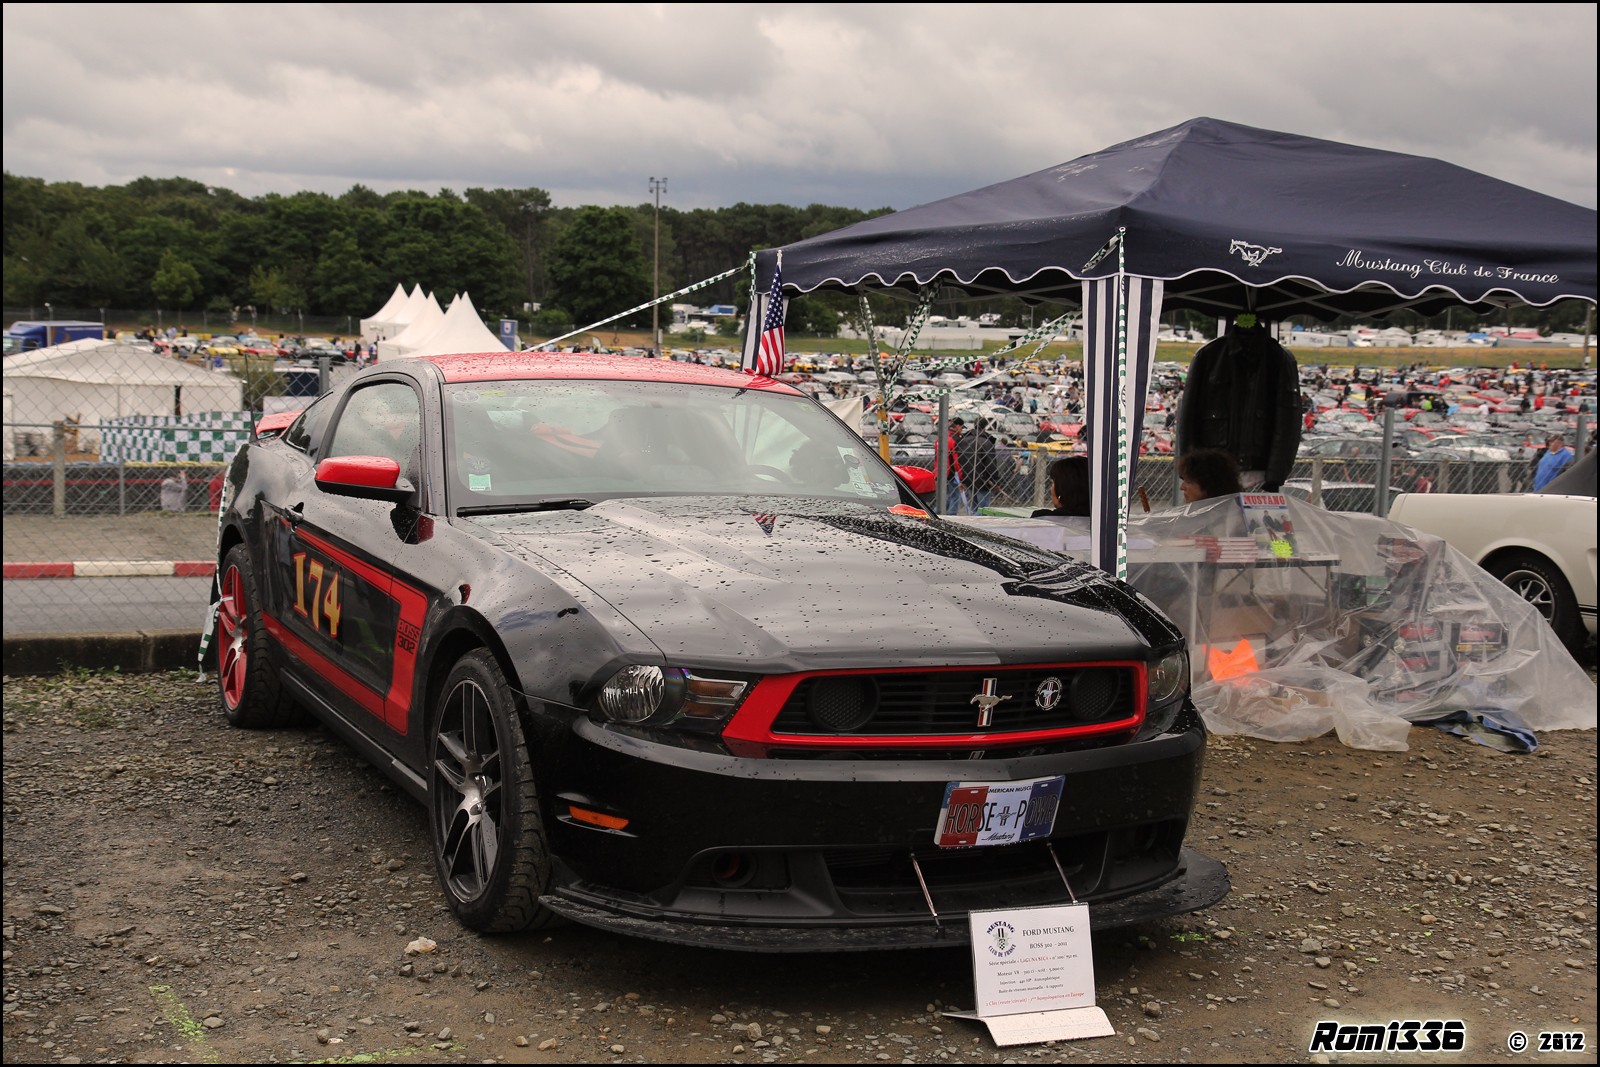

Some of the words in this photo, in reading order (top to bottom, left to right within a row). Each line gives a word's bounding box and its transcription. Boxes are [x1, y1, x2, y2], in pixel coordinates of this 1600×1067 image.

[1336, 249, 1422, 279] Mustang
[1424, 259, 1467, 276] Club
[1473, 266, 1493, 278] de
[1496, 266, 1559, 284] France
[1244, 495, 1286, 505] MUSTANG
[293, 552, 342, 638] 174
[397, 619, 421, 641] BOSS
[397, 636, 416, 654] 302
[943, 802, 997, 834] HORSE
[987, 921, 1015, 934] MUSTANG
[1022, 928, 1042, 937] FORD
[1042, 926, 1074, 935] MUSTANG
